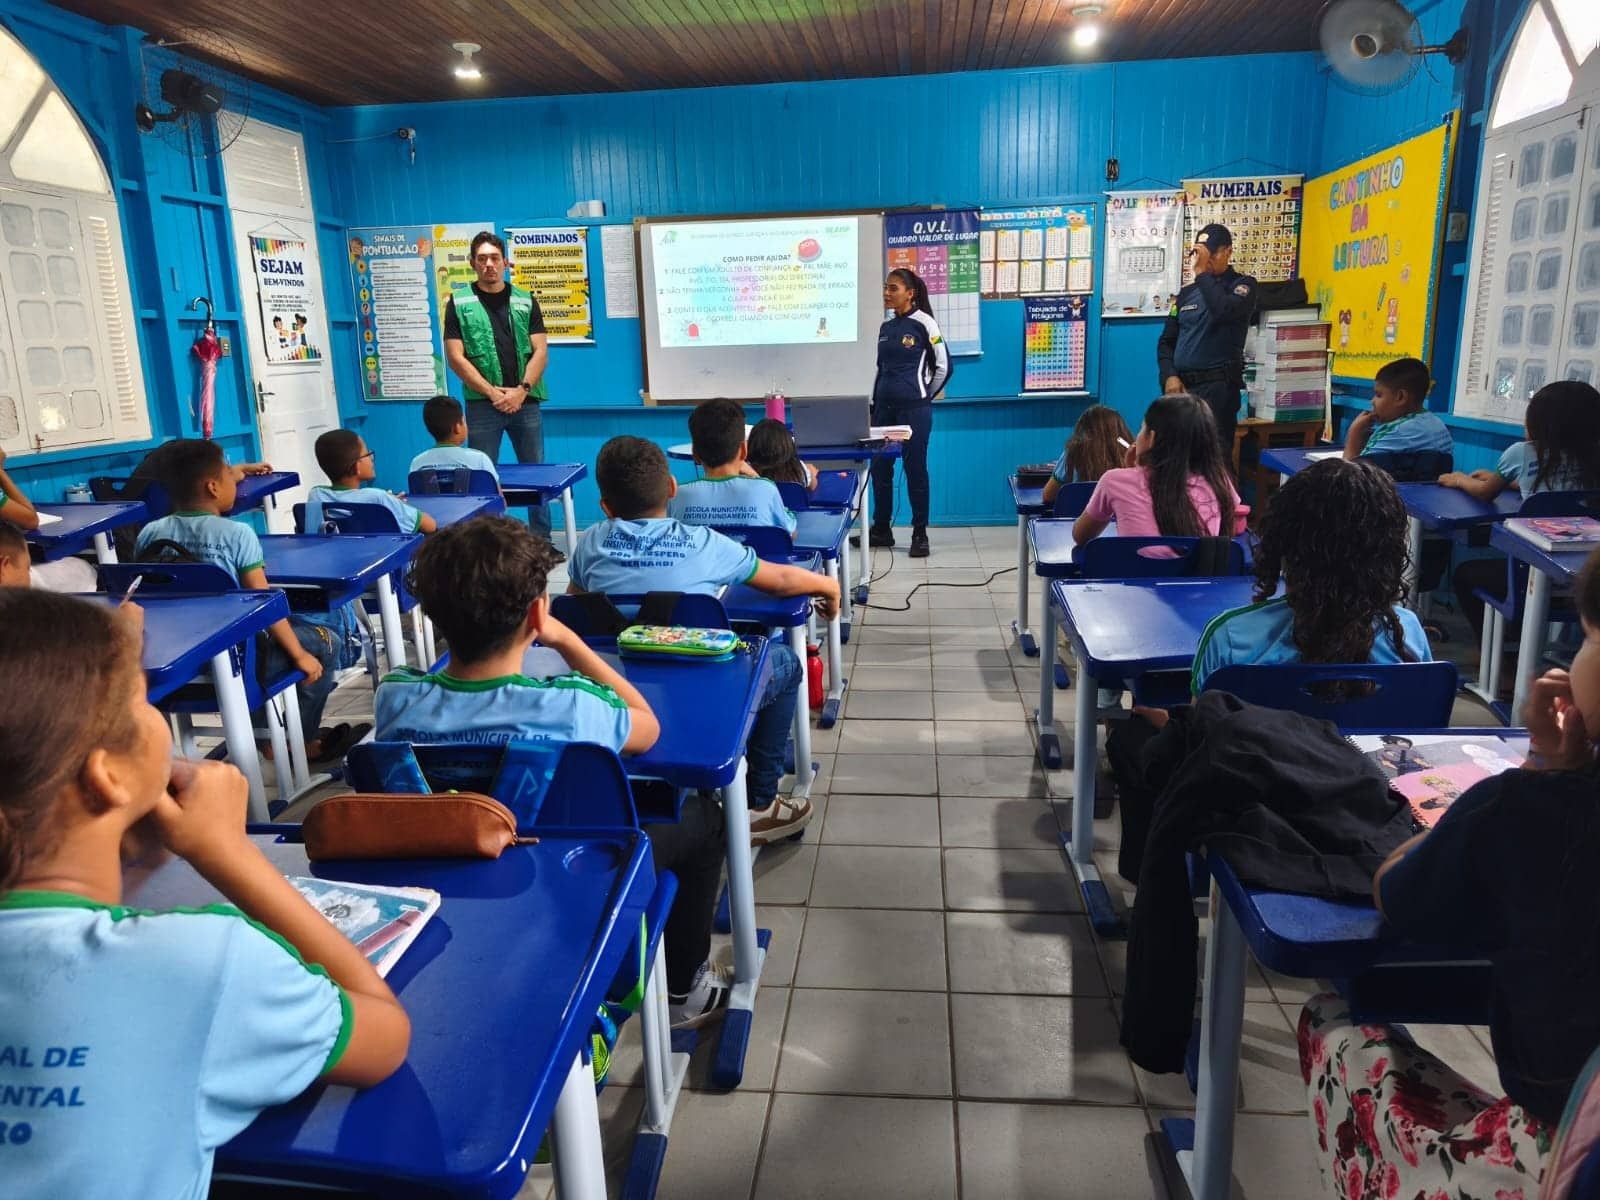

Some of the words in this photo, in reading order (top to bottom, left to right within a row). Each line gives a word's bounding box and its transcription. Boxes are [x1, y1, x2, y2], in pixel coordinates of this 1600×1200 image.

[1200, 180, 1282, 198] NUMERAIS
[1330, 155, 1404, 210] CANTINHO
[1350, 203, 1369, 233] DA
[913, 220, 952, 234] Q.V.L.
[374, 234, 396, 243] SINAIS
[513, 233, 579, 245] COMBINADOS
[888, 234, 918, 244] QUADRO
[919, 233, 943, 242] VALOR
[944, 233, 955, 241] DE
[955, 231, 979, 240] LUGAR
[1333, 234, 1389, 272] LEITURA
[260, 258, 304, 275] SEJAM
[708, 512, 758, 520] FUNDAMENTAL
[711, 505, 749, 513] MUNICIPAL
[42, 1045, 91, 1069] DE
[0, 1085, 86, 1108] NTAL
